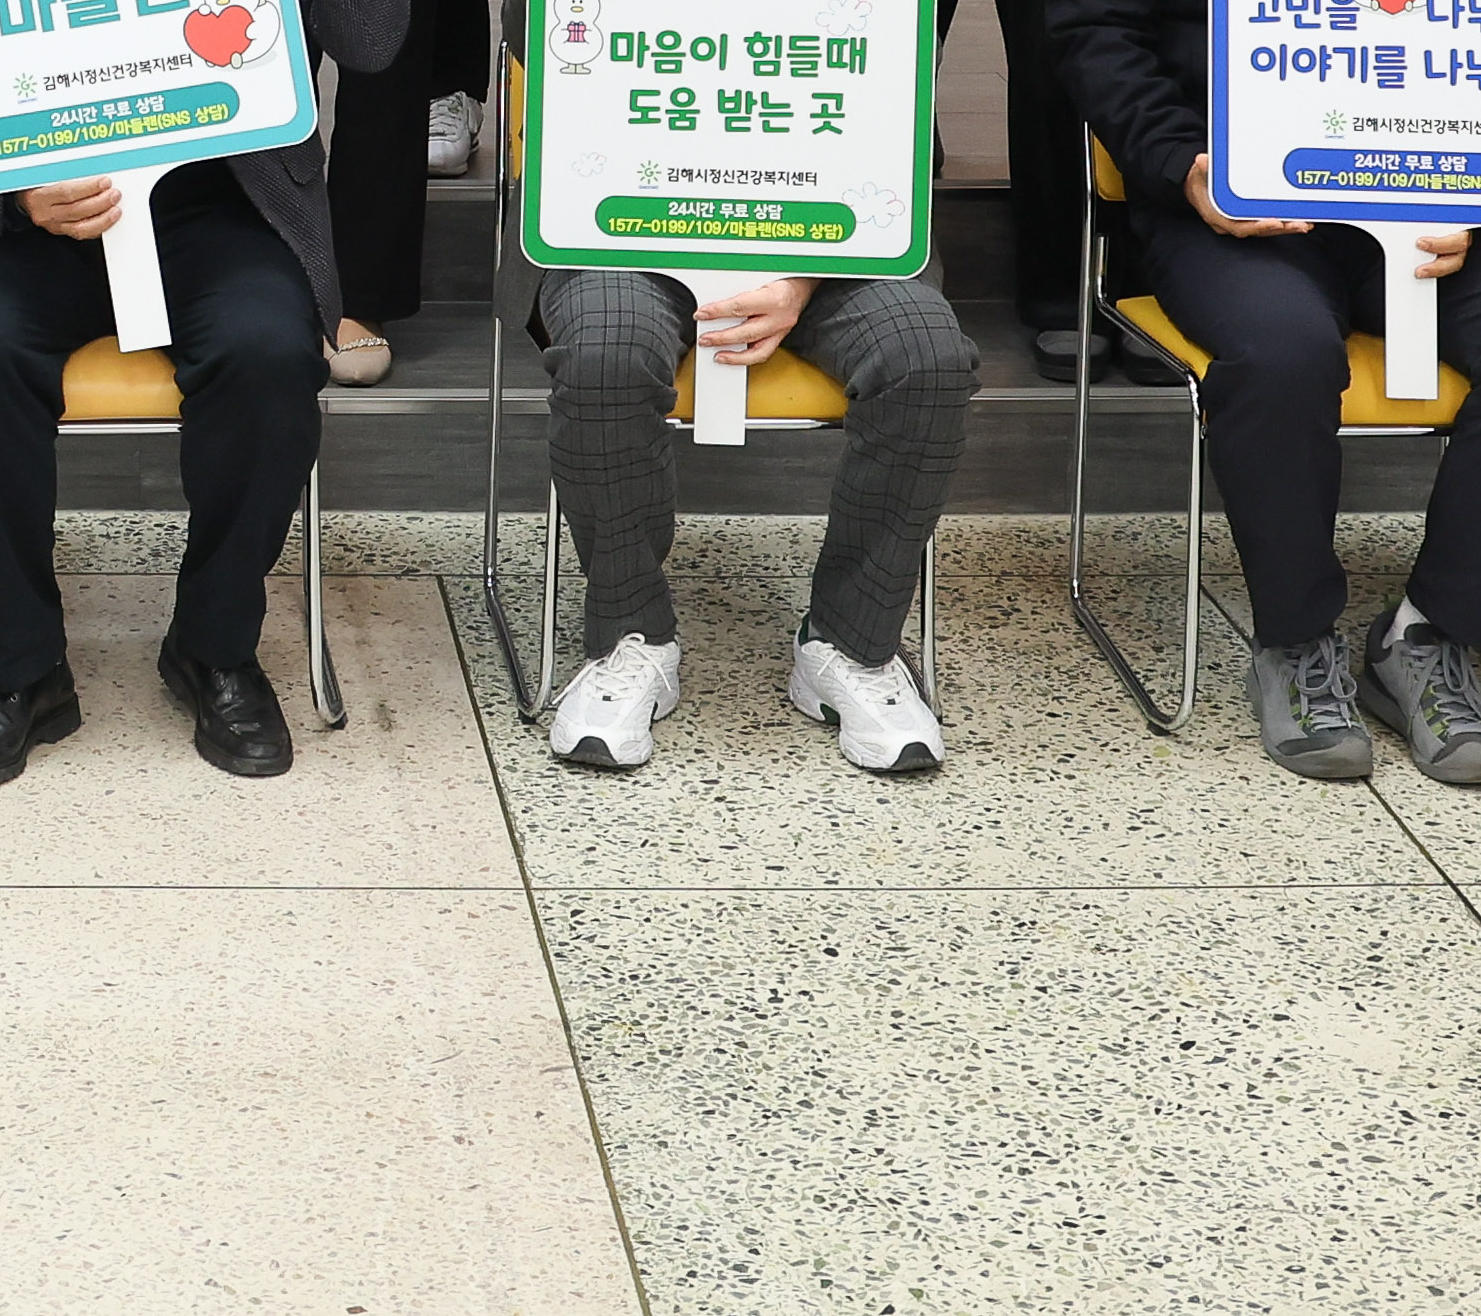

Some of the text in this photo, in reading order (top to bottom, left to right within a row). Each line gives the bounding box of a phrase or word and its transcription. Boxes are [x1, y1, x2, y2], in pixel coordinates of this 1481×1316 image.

[609, 30, 867, 78] 마음이 힘들때
[1250, 44, 1408, 89] 이야기를
[42, 52, 194, 91] 김해시정신건강복지센터
[50, 94, 165, 128] 24시간 무료 상담
[194, 103, 229, 124] 상담)
[628, 87, 846, 135] 도움 받는 곳
[1354, 153, 1468, 171] 24시간 무료 상담
[666, 166, 818, 187] 김해시정신건강복지센터
[668, 202, 783, 221] 24시간 무료 상담
[608, 218, 843, 241] 1577-0199/109/마들랜(SNS 상담)
